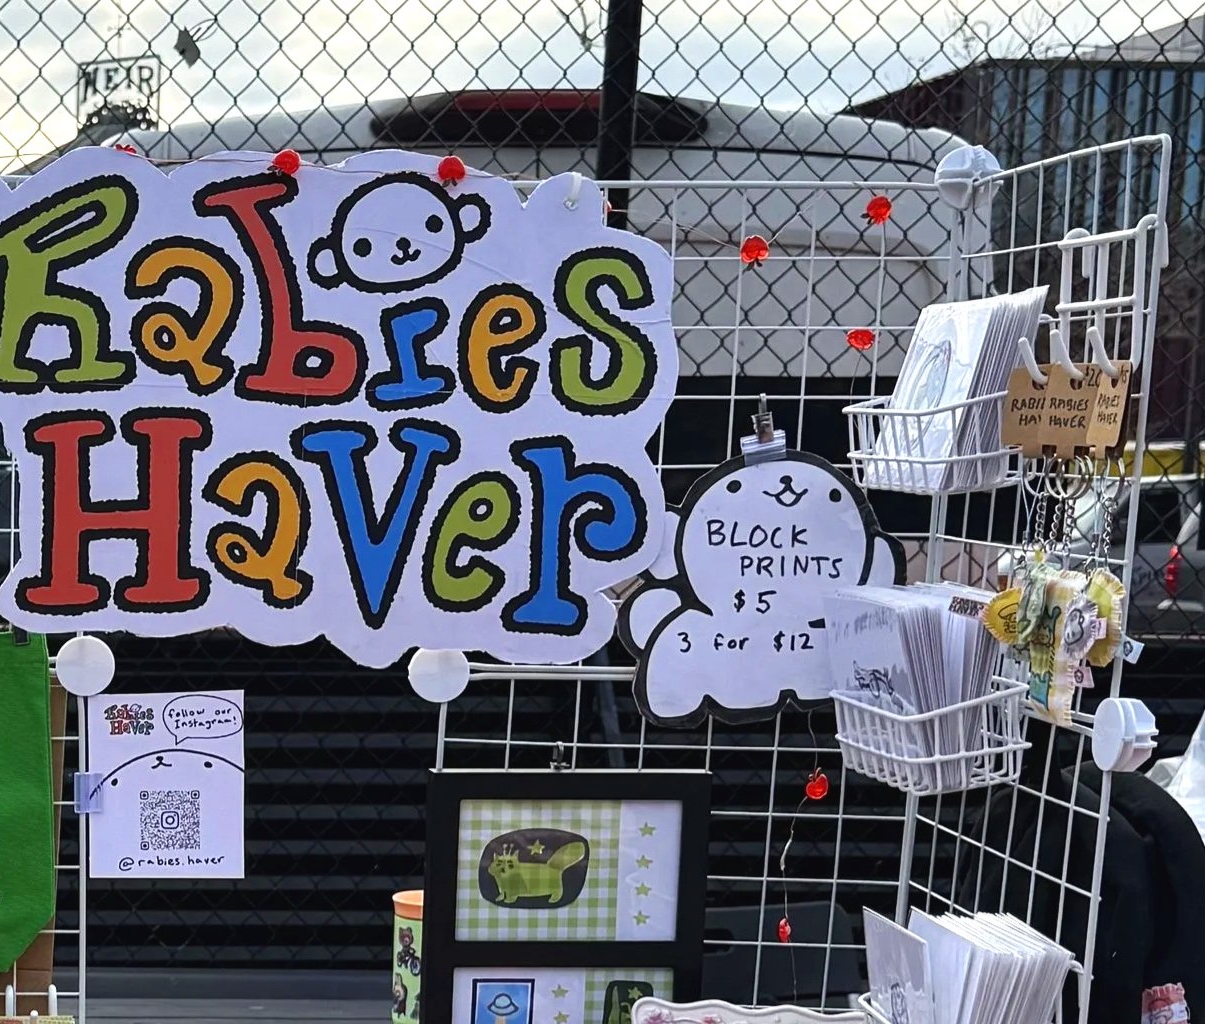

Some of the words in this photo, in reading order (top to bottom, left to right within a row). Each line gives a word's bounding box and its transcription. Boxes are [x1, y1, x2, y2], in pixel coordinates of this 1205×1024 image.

[1011, 398, 1046, 412] RABI
[1049, 398, 1090, 412] RABIES
[1049, 415, 1087, 428] HAVER
[707, 519, 808, 549] BLOCK
[740, 555, 843, 579] PRINTS
[677, 632, 692, 653] 3
[713, 633, 749, 650] for
[773, 630, 814, 653] $12
[215, 708, 232, 716] our
[174, 715, 237, 730] Instagram!
